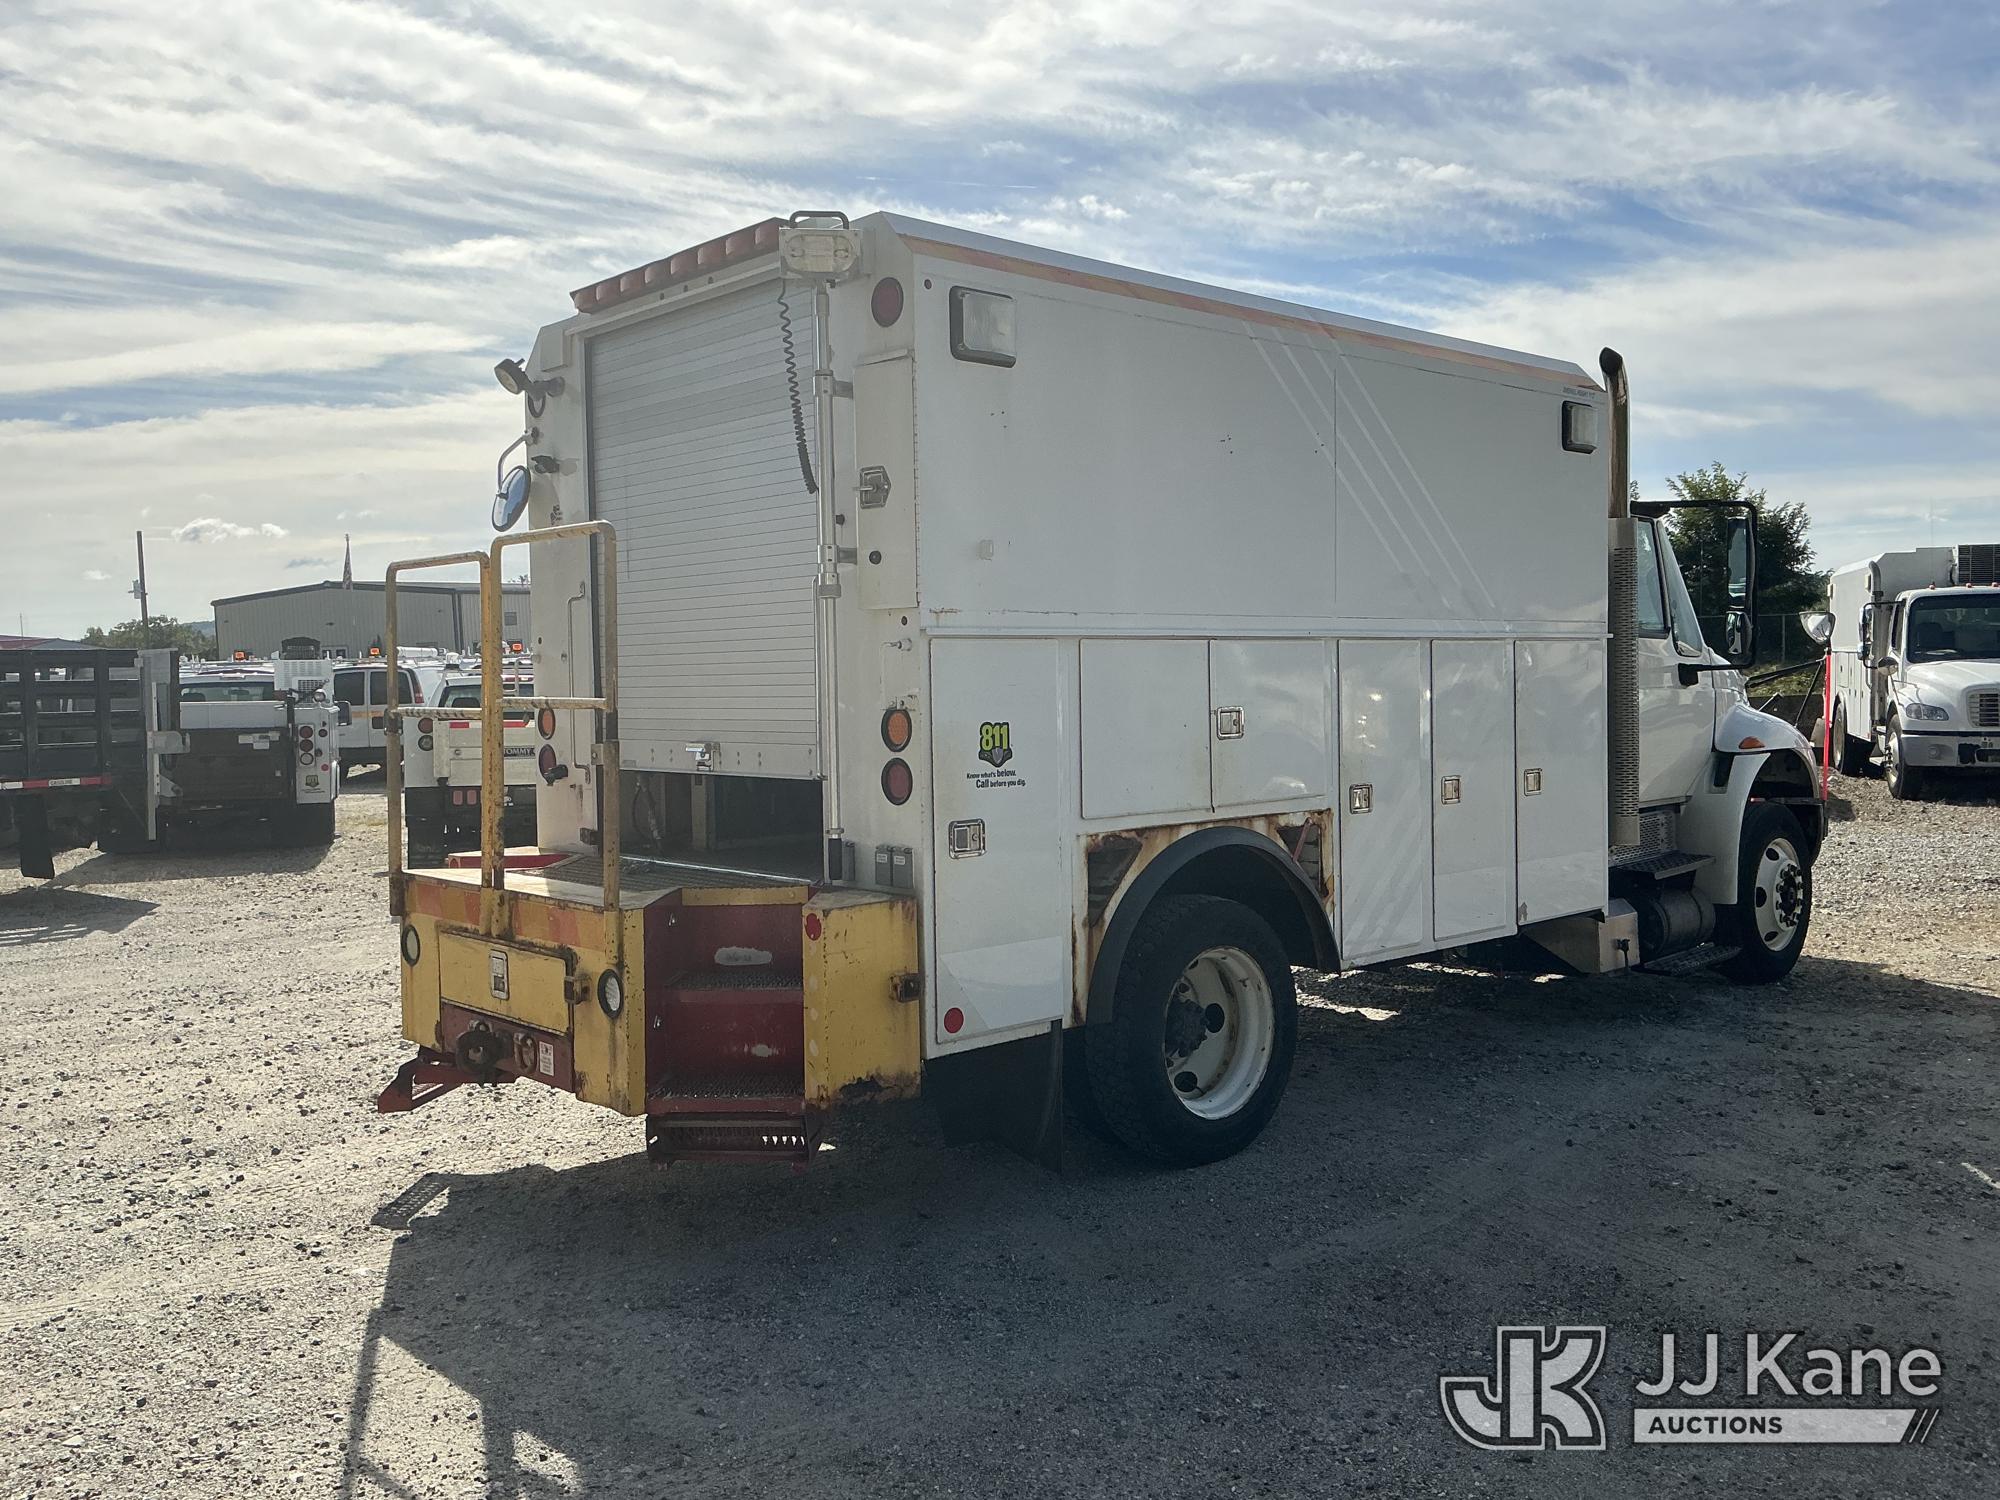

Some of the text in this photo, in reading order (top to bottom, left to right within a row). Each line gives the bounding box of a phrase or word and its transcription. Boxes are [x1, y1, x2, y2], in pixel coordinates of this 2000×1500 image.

[980, 722, 1009, 751] 811
[997, 769, 1017, 777] below.
[976, 779, 989, 788] Call
